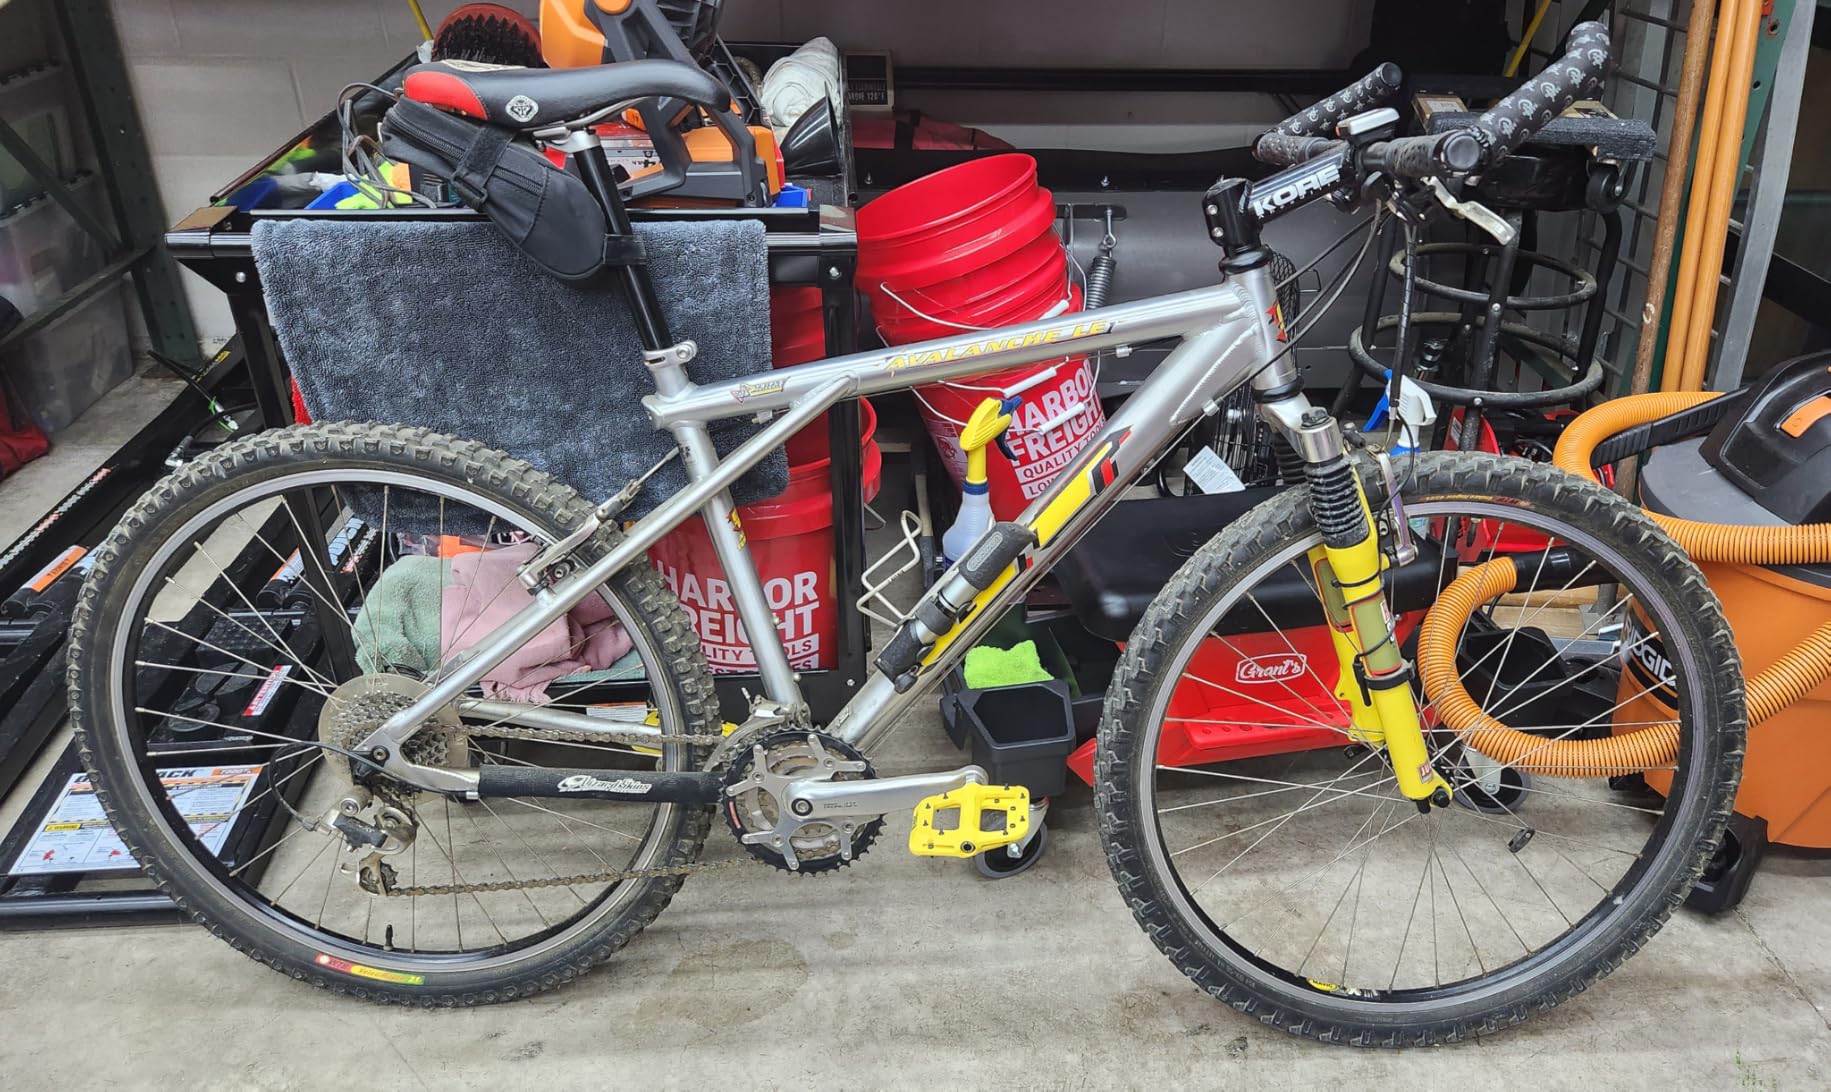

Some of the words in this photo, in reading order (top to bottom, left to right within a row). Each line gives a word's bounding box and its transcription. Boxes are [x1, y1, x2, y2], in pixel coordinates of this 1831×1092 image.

[1253, 164, 1340, 217] KORE
[885, 328, 1062, 371] AVALANCHE
[1023, 444, 1082, 479] QUALITY
[657, 560, 818, 612] HAROR
[680, 601, 820, 645] REIHT
[702, 645, 742, 661] LITY
[1239, 659, 1301, 679] Grant's
